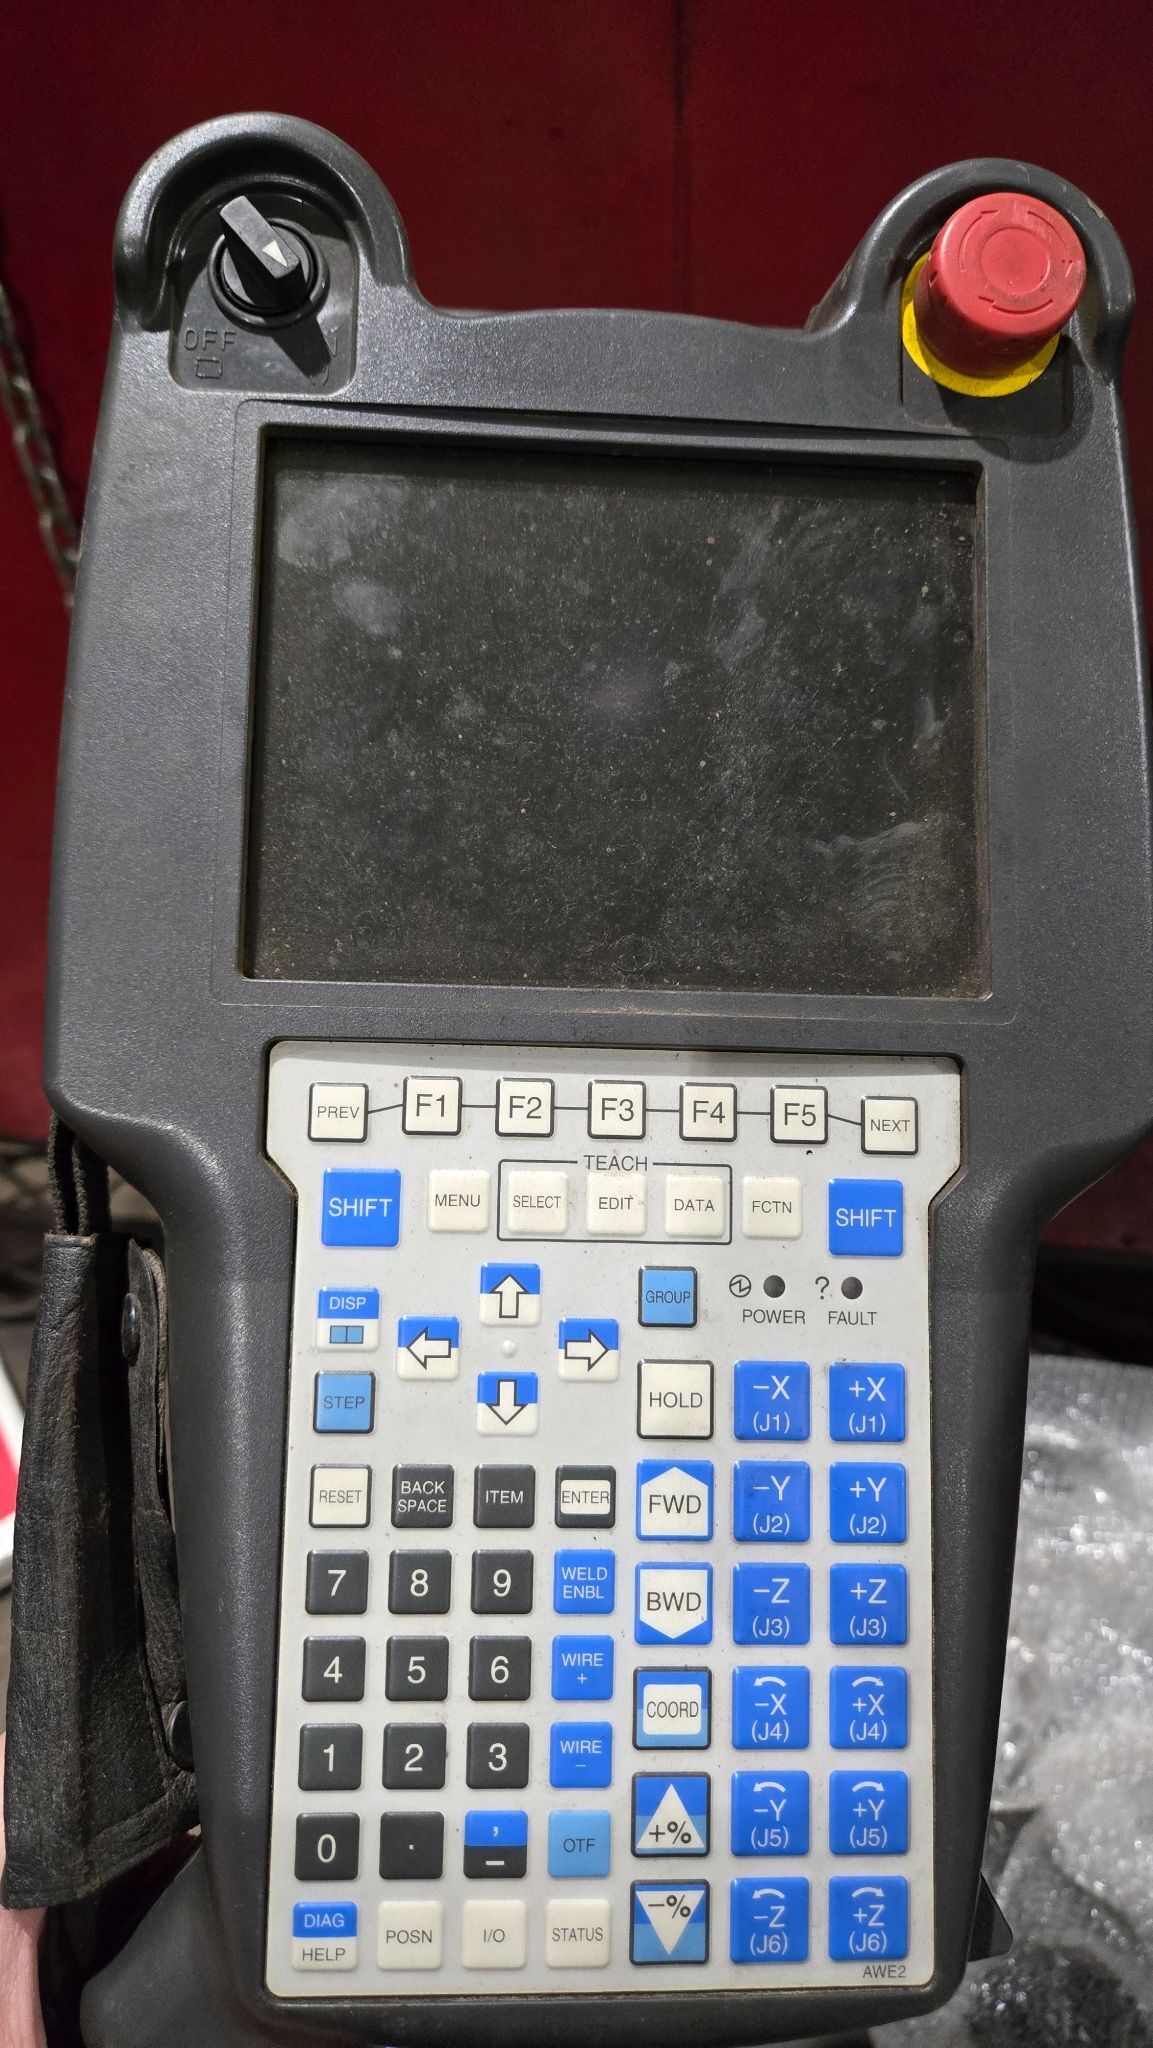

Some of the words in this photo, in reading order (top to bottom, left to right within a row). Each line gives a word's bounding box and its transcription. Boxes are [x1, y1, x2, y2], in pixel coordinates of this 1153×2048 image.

[183, 328, 238, 352] OFF
[317, 1106, 360, 1119] PREV
[415, 1093, 446, 1118] F1
[508, 1096, 542, 1119] F2
[600, 1098, 635, 1122] F3
[693, 1101, 726, 1124] F4
[783, 1103, 817, 1127] F5
[870, 1119, 911, 1132] NEXT
[584, 1154, 648, 1172] TEACH
[328, 1198, 393, 1218] SHIFT
[434, 1194, 481, 1207] MENU
[513, 1195, 562, 1209] SELECT
[598, 1197, 634, 1210] EDIT
[674, 1199, 715, 1213] DATA
[752, 1201, 792, 1214] FCTN
[835, 1208, 897, 1229] SHIFT
[329, 1296, 367, 1311] DISP
[645, 1291, 691, 1304] GROUP
[742, 1309, 806, 1325] POWER
[828, 1311, 877, 1326] FAULT
[650, 1392, 703, 1408] HOLD
[849, 1377, 886, 1402] +X
[323, 1396, 366, 1410] STEP
[753, 1413, 791, 1434] (J1)
[849, 1414, 886, 1435] (J1)
[319, 1490, 362, 1504] RESET
[401, 1481, 445, 1495] BACK
[486, 1490, 524, 1504] ITEM
[562, 1491, 610, 1504] ENTER
[850, 1477, 887, 1502] +Y
[398, 1499, 447, 1513] SPACE
[649, 1495, 702, 1514] FWD
[753, 1513, 791, 1536] (J2)
[850, 1514, 887, 1537] (J2)
[327, 1569, 347, 1597] 7
[410, 1569, 429, 1597] 8
[493, 1569, 512, 1597] 9
[562, 1567, 608, 1581] WELD
[563, 1585, 604, 1600] ENBL
[647, 1592, 702, 1612] BWD
[850, 1579, 887, 1604] +Z
[752, 1615, 790, 1639] (J3)
[850, 1615, 887, 1639] (J3)
[323, 1656, 343, 1683] 4
[407, 1656, 426, 1684] 5
[490, 1656, 510, 1684] 6
[562, 1653, 604, 1667] WIRE
[646, 1700, 699, 1719] COORD
[853, 1694, 885, 1716] +X
[752, 1720, 790, 1742] (J4)
[850, 1720, 887, 1743] (J4)
[323, 1743, 335, 1772] 1
[404, 1744, 424, 1772] 2
[488, 1743, 508, 1771] 3
[560, 1740, 602, 1755] WIRE
[853, 1799, 885, 1822] +Y
[649, 1821, 692, 1845] +%
[751, 1826, 789, 1849] (J5)
[850, 1826, 887, 1849] (J5)
[317, 1833, 337, 1863] 0
[563, 1838, 596, 1853] OTF
[304, 1914, 345, 1928] DIAG
[853, 1905, 885, 1927] +Z
[386, 1930, 433, 1944] POSN
[483, 1928, 506, 1943] I/O
[552, 1927, 603, 1942] STATUS
[849, 1933, 887, 1954] (J6)
[302, 1948, 346, 1962] HELP
[750, 1935, 788, 1956] (J6)
[863, 1965, 906, 1979] AWE2
